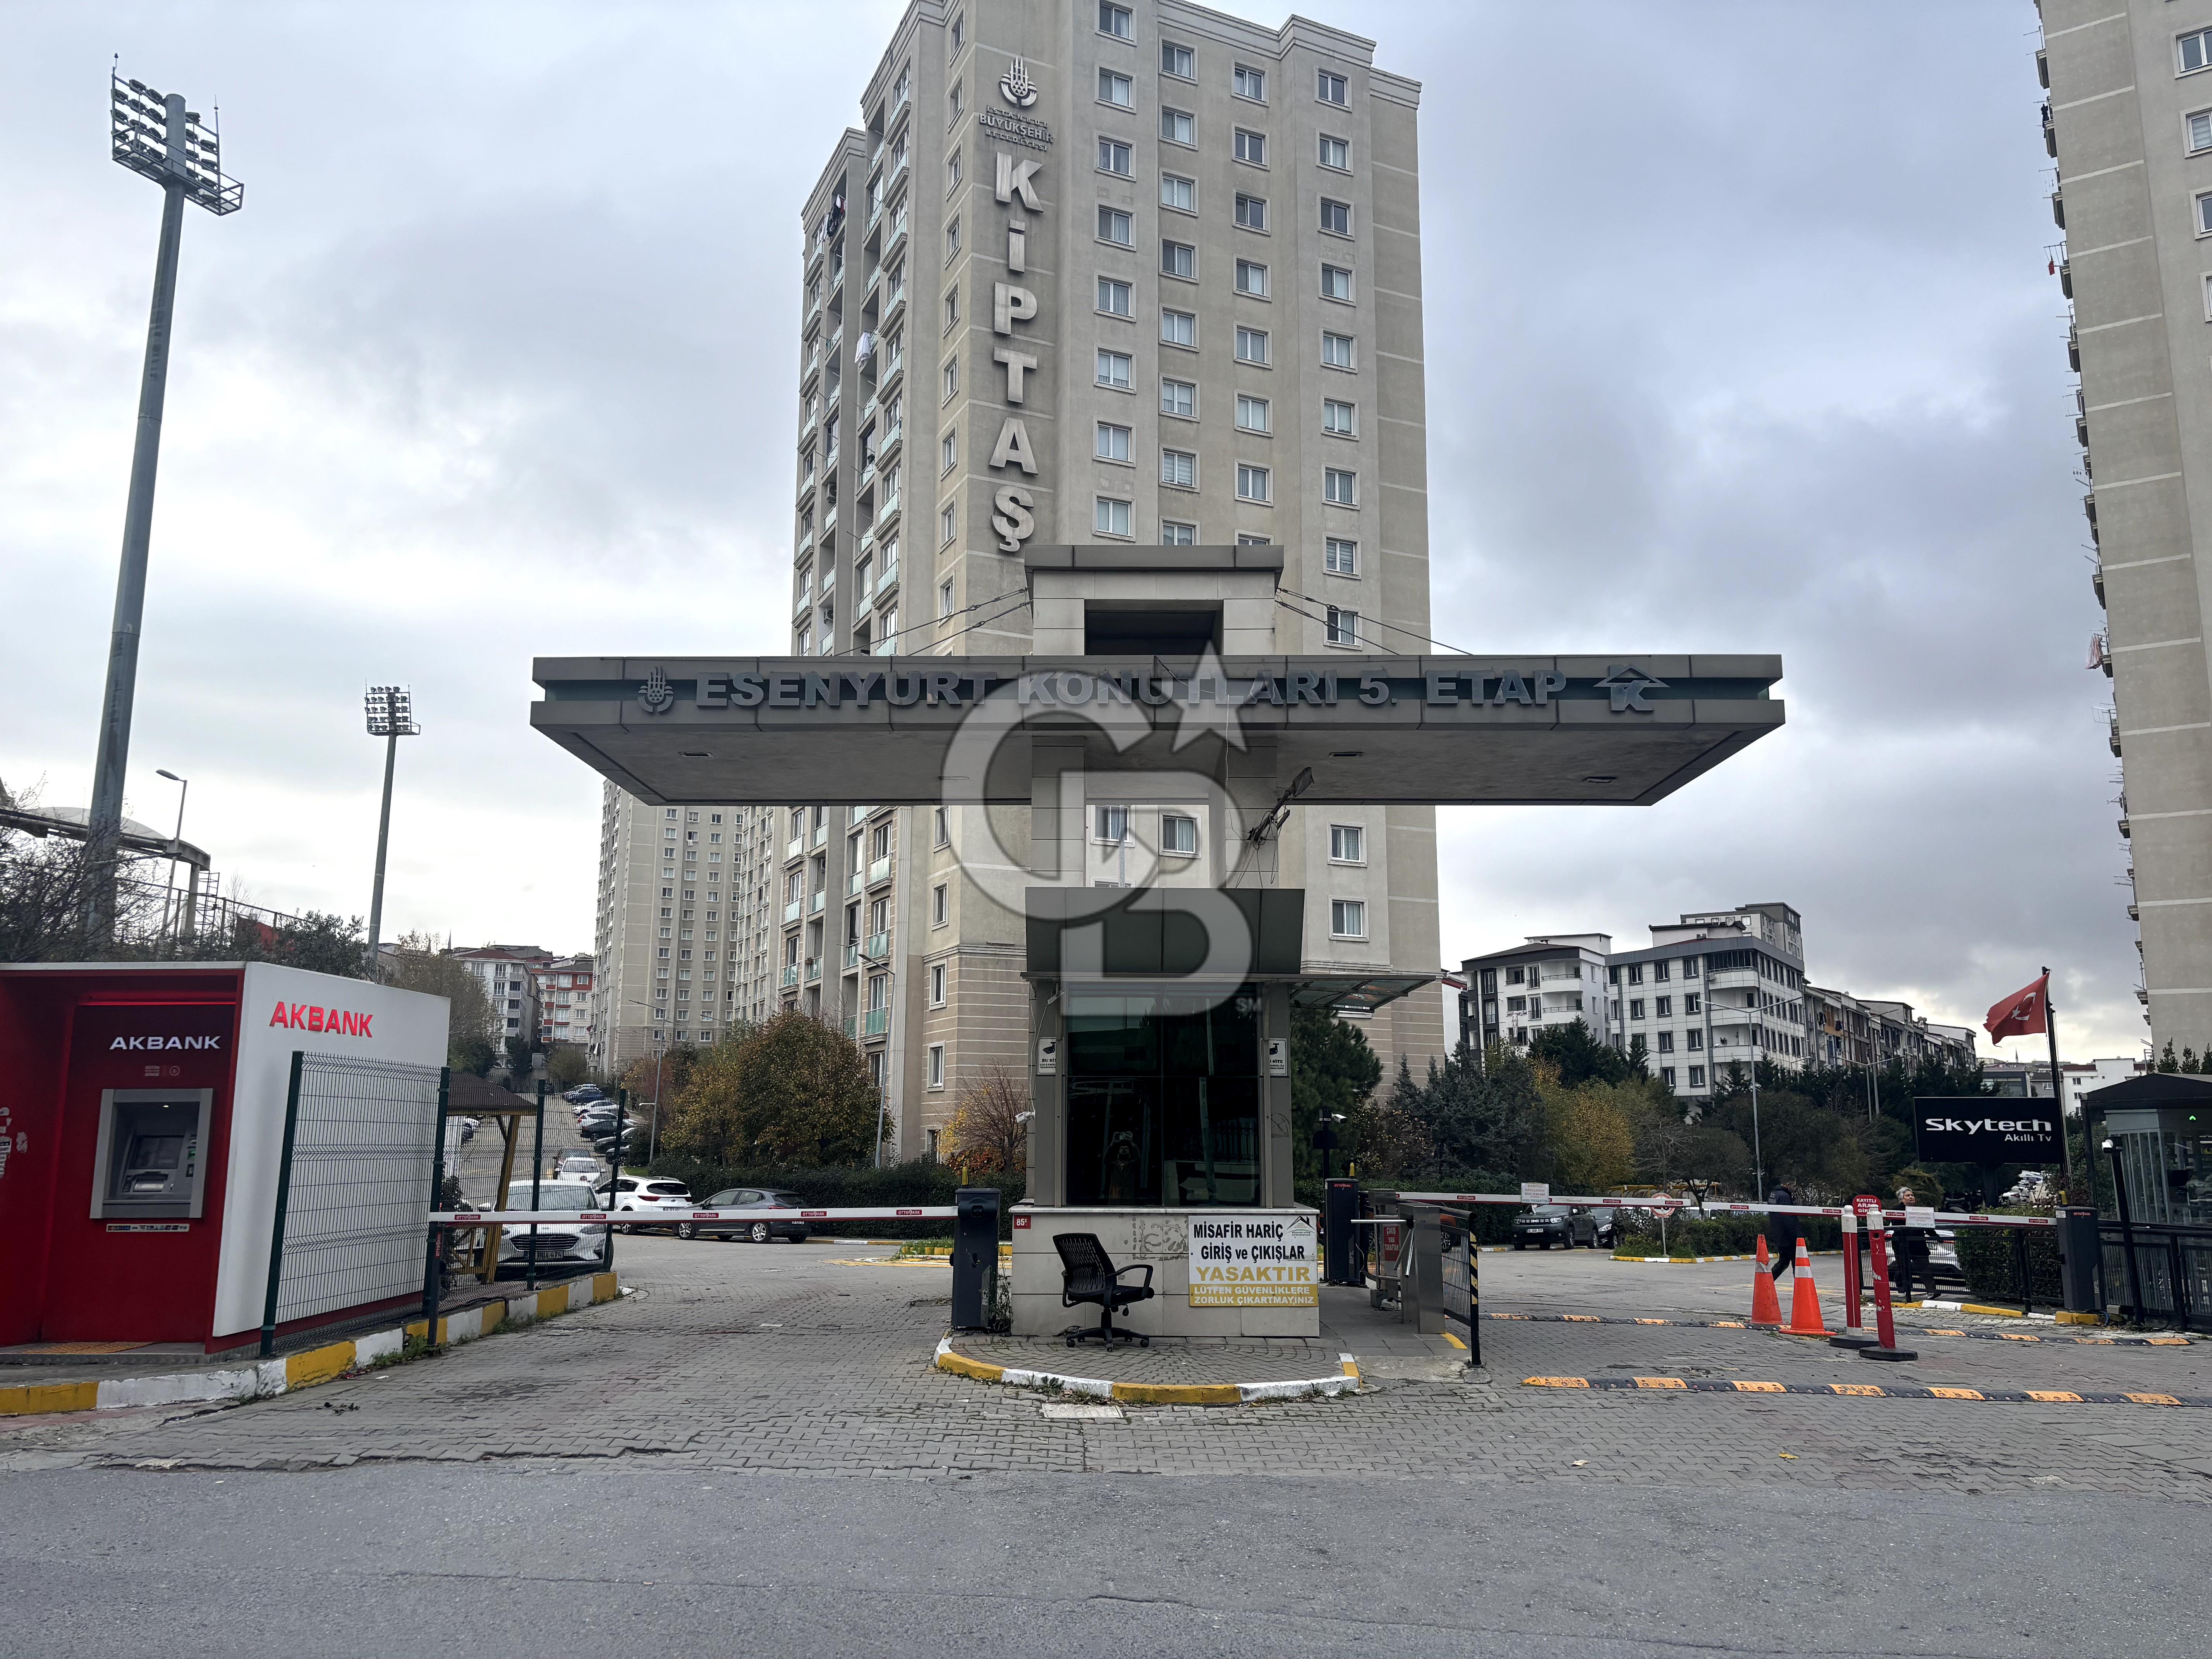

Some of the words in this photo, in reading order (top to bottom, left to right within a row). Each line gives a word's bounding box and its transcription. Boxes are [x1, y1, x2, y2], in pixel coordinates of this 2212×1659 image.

[979, 113, 1053, 144] BÜYÜKŞEHİR
[989, 151, 1044, 552] KİPTAŞ
[696, 671, 996, 707] ESENYURT
[1017, 670, 1338, 706] KONUTLARI
[1359, 670, 1397, 705] 5.
[1425, 670, 1566, 705] ETAP
[269, 1001, 373, 1038] AKBANK
[109, 1036, 221, 1050] AKBANK
[1925, 1118, 2052, 1134] Skytech
[1194, 1221, 1242, 1238] MİSAFİR
[1247, 1221, 1283, 1242] HARİÇ
[1201, 1242, 1231, 1263] GİRİŞ
[1235, 1249, 1248, 1259] ve
[1251, 1245, 1305, 1263] ÇIKIŞLAR
[1196, 1266, 1310, 1281] YASAKTIR
[1195, 1285, 1231, 1294] LÜTFEN
[1235, 1285, 1310, 1295] GÜVENLİKLERE
[1237, 1296, 1314, 1306] ÇIKARTMAYINIZ
